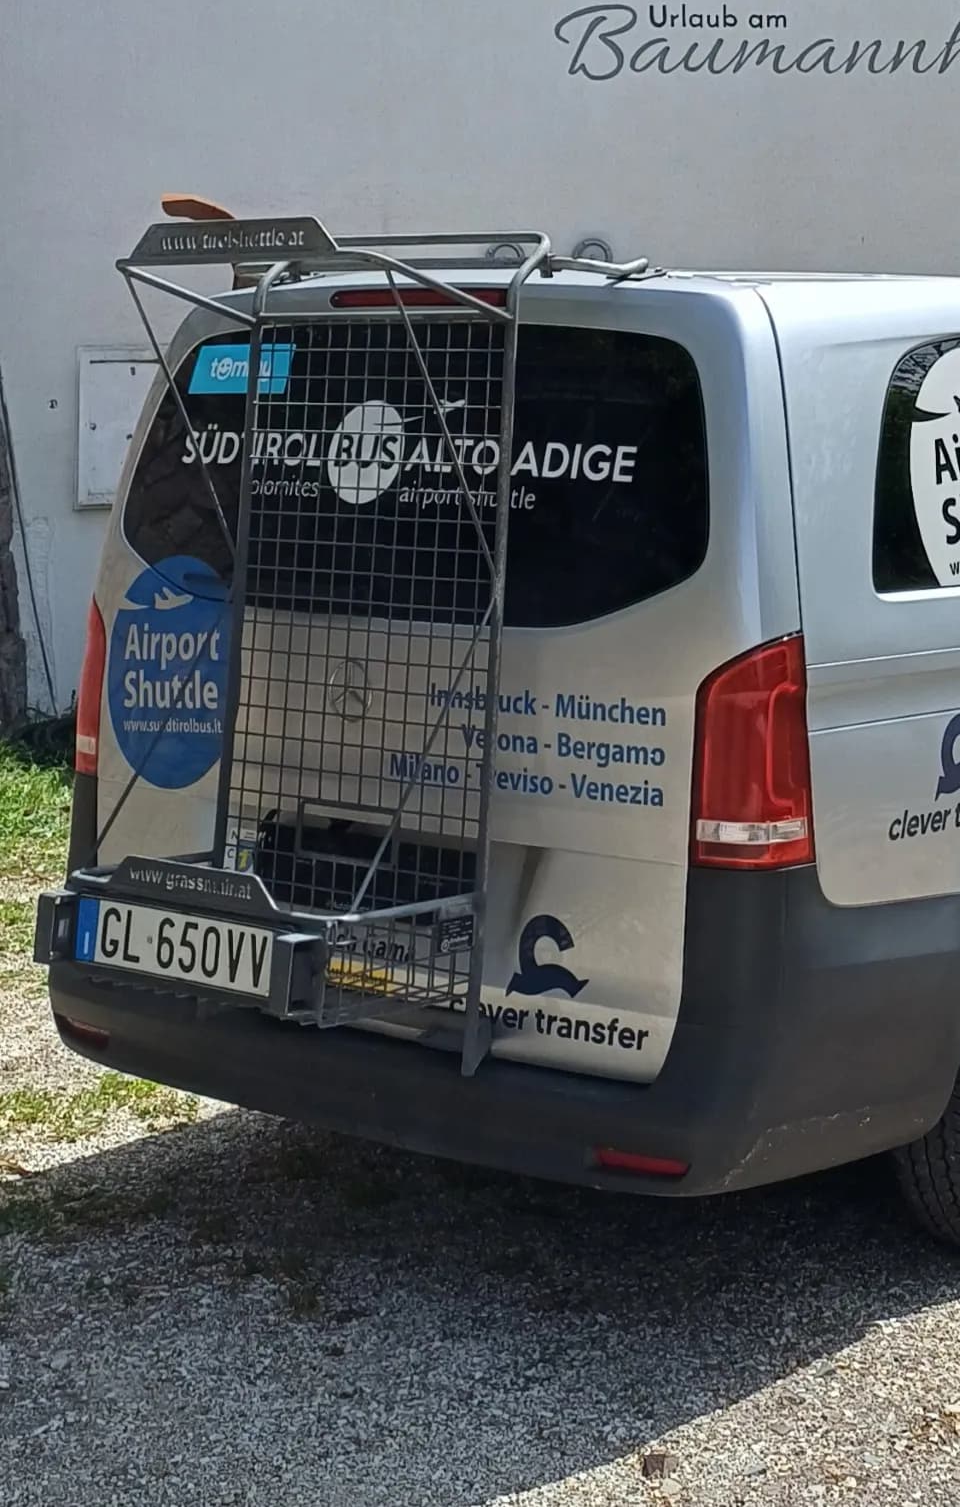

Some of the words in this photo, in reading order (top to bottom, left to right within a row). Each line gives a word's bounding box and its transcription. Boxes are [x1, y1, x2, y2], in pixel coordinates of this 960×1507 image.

[649, 4, 737, 29] Urlaub
[748, 10, 787, 29] am
[210, 357, 272, 382] tomy
[181, 424, 321, 467] SÜDIROL
[333, 434, 400, 470] BUS
[404, 437, 500, 476] ALTO
[510, 441, 638, 483] ADIGE
[250, 475, 320, 498] olomites
[470, 485, 536, 510] shutle
[124, 623, 220, 670] Airport
[123, 669, 218, 709] Shuttle
[430, 683, 537, 716] Innsbuck
[555, 694, 667, 726] München
[123, 718, 223, 734] www.sudtirolbus.it
[462, 724, 538, 754] Veona
[557, 733, 666, 768] Bergamo
[390, 753, 460, 784] Milano
[476, 763, 553, 795] eviso
[571, 773, 664, 807] Venezia
[888, 805, 950, 841] clever
[101, 907, 140, 963] GL
[156, 917, 268, 989] 650VV
[535, 1008, 649, 1050] transfer
